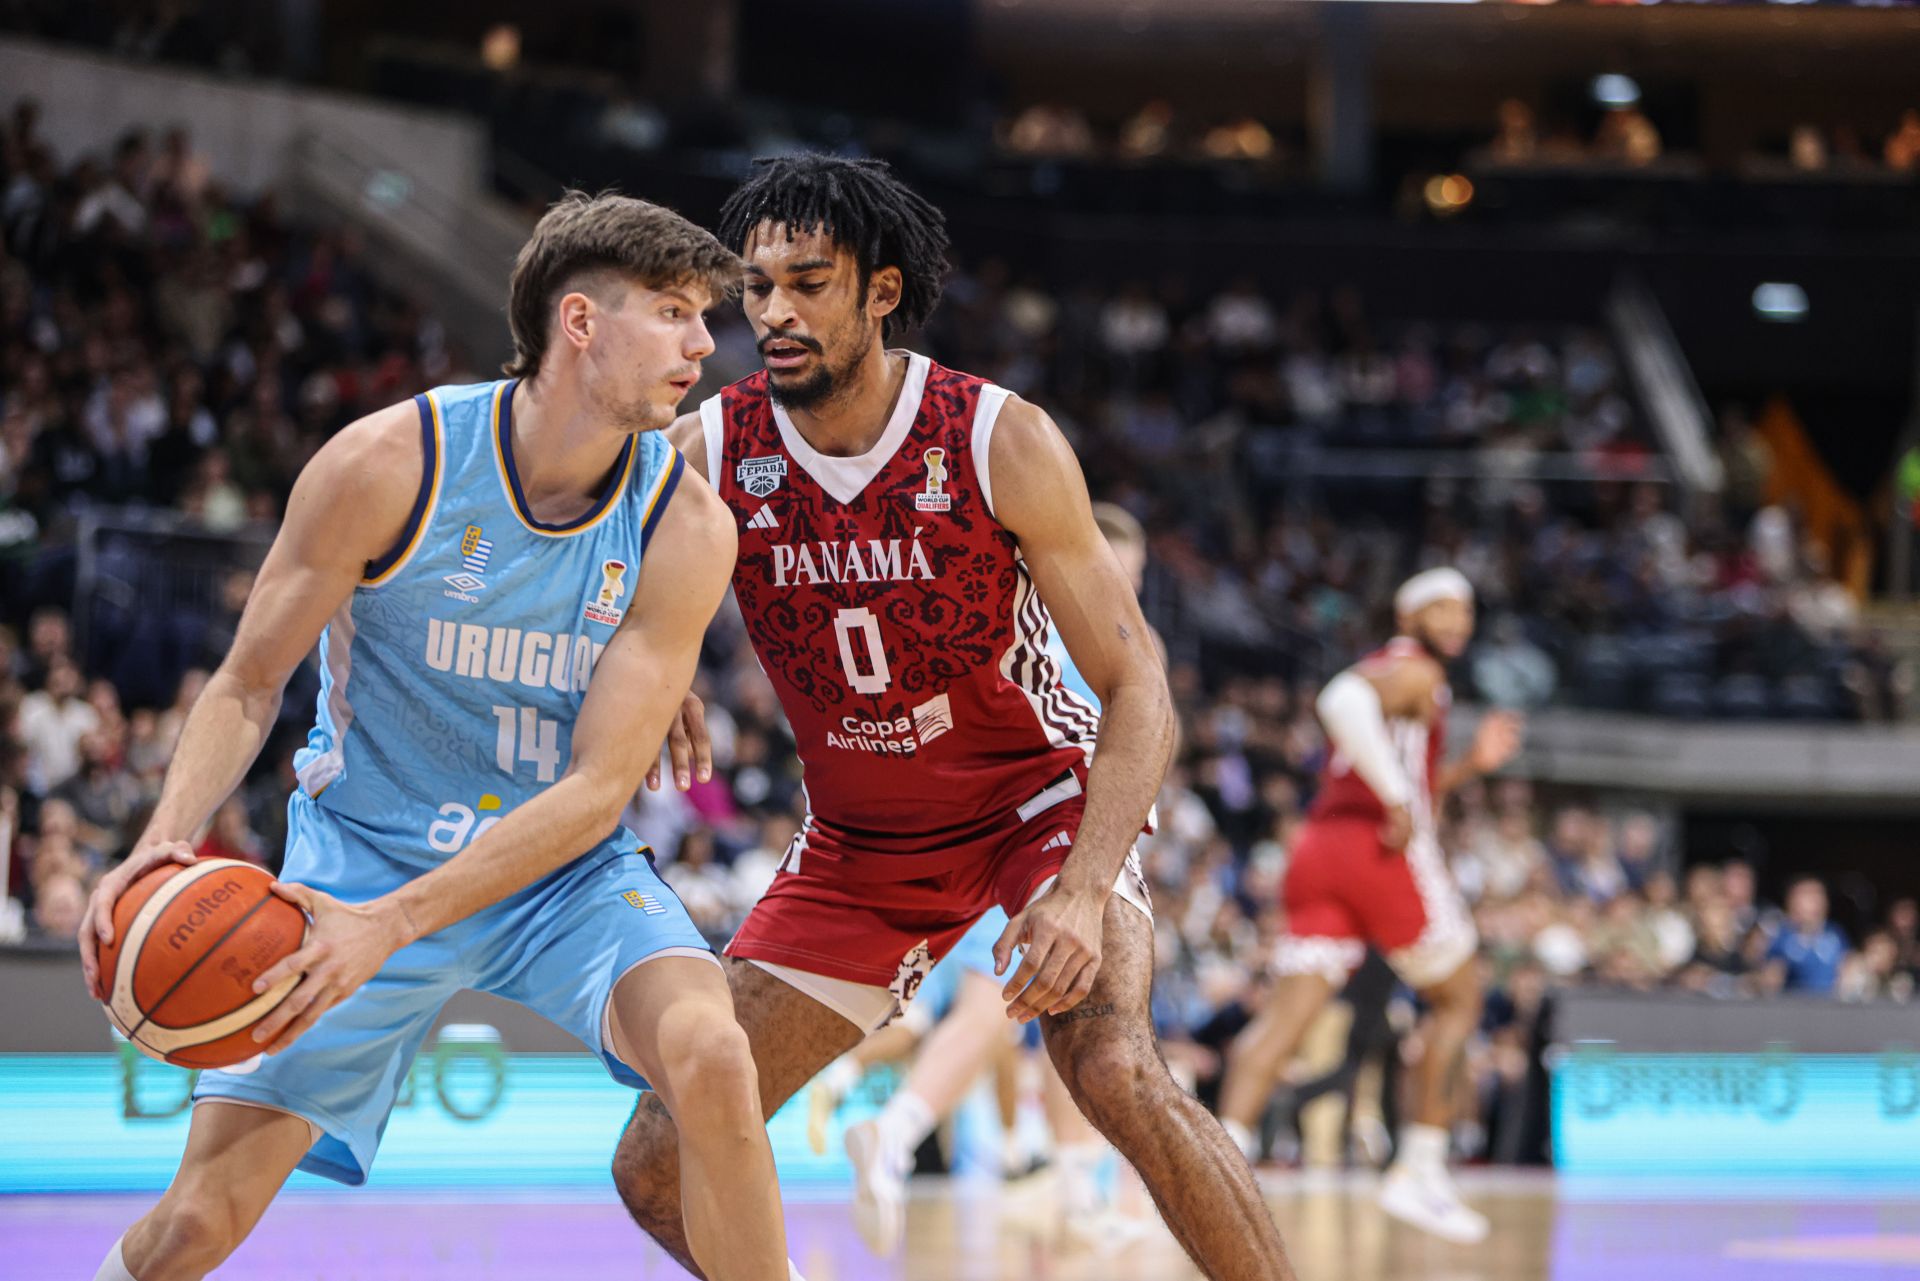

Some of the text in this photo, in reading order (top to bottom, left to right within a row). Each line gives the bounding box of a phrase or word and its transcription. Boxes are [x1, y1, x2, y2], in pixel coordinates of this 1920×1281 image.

[738, 461, 786, 479] FEPABA
[770, 526, 936, 587] PANAMÁ
[444, 589, 479, 604] umbro
[833, 606, 892, 694] 0
[492, 705, 560, 783] 14
[827, 731, 917, 754] Airlines
[842, 716, 911, 738] Copa
[167, 879, 244, 950] molten
